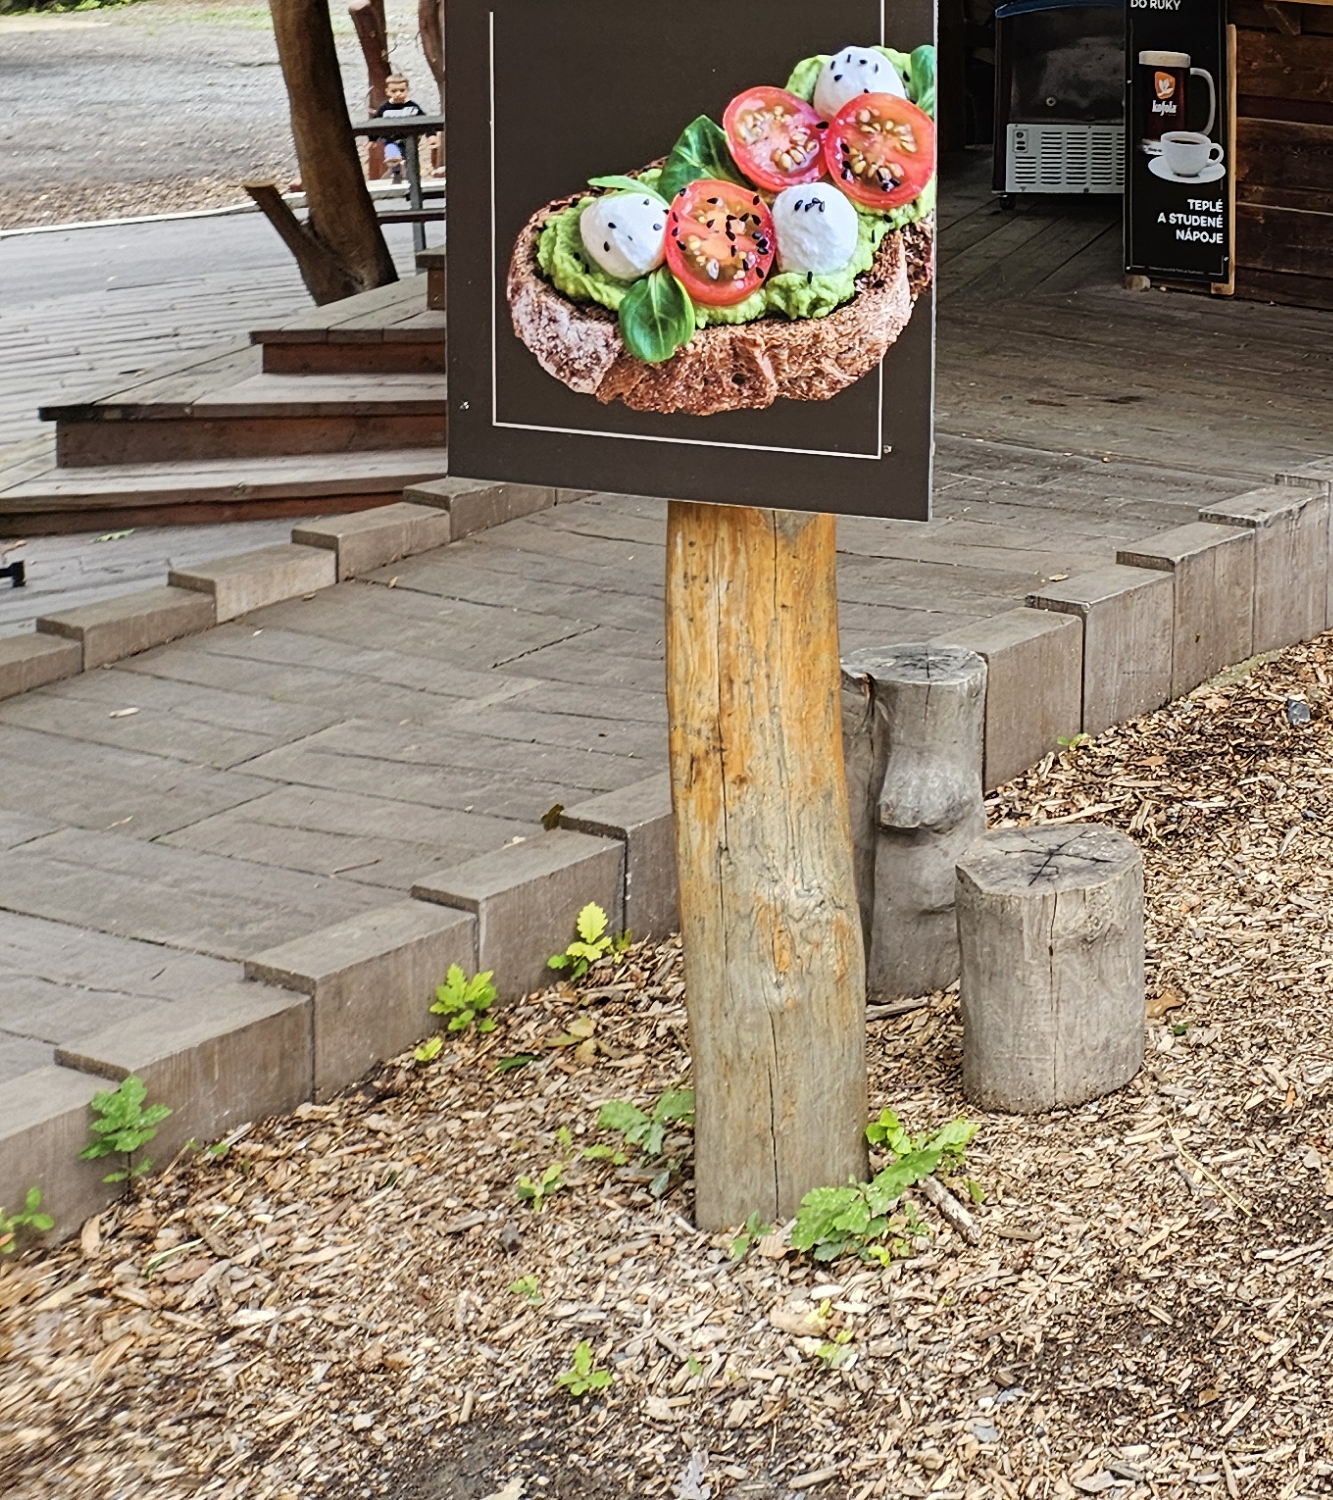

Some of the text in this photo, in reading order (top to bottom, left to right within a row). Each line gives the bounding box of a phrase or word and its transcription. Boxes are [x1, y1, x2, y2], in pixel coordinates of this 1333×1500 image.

[1187, 199, 1223, 212] TEPLÉ
[1157, 212, 1223, 228] A STUDENÉ
[1175, 227, 1224, 244] NÁPOJE
